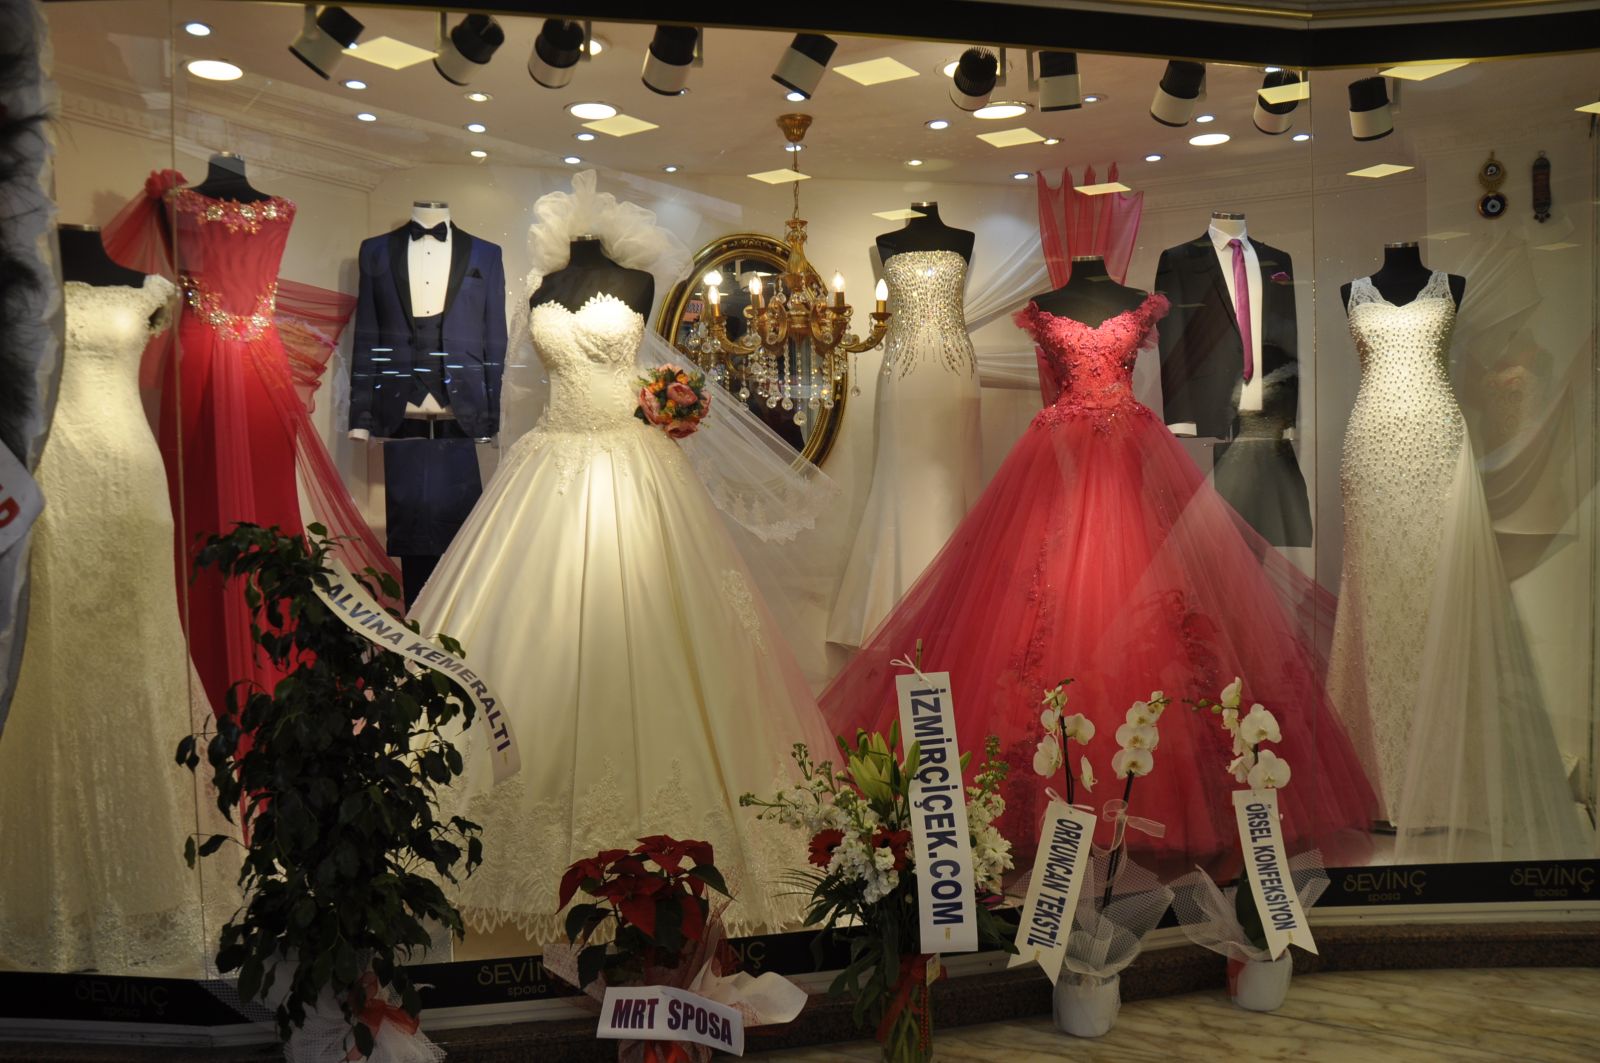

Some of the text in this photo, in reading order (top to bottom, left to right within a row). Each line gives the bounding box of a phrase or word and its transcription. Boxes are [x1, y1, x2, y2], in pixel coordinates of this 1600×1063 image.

[328, 583, 511, 752] ALVİNA KEMERALTI
[909, 688, 964, 925] İZMİRÇİÇEK.COM
[1246, 803, 1297, 931] ÖRSEL KONFEKSİYON
[1027, 818, 1083, 949] ORKUNCAN TEKSTİL
[611, 998, 733, 1046] MRT SPOSA
